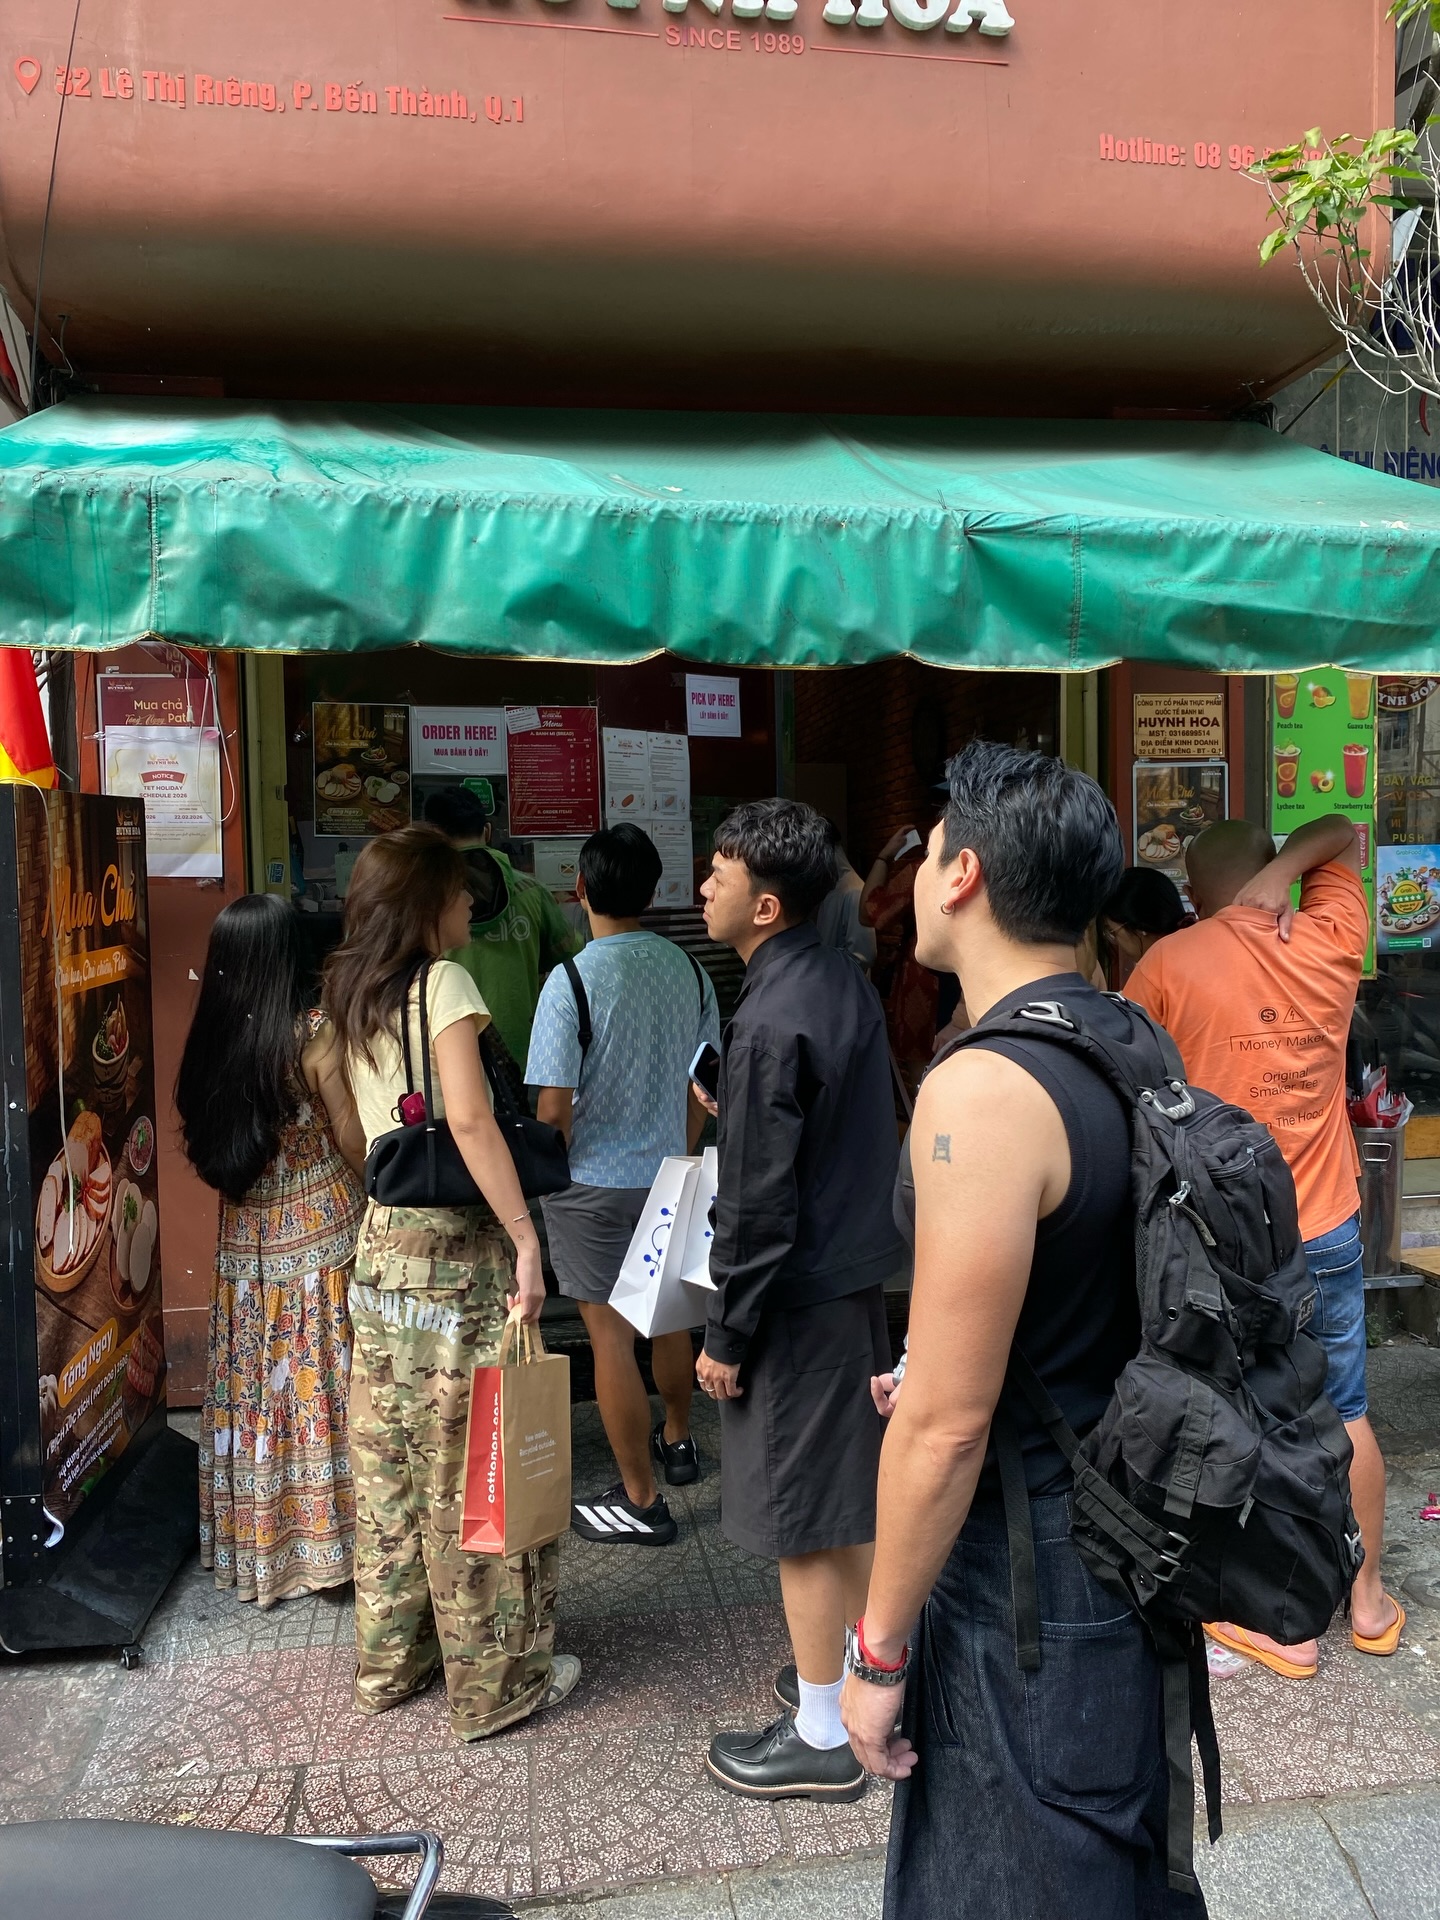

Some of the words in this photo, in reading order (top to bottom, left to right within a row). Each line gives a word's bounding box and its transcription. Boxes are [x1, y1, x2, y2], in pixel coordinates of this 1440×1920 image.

[665, 25, 742, 51] SINCE
[750, 32, 806, 55] 1989
[55, 65, 92, 97] 32
[100, 67, 134, 99] Lê
[142, 71, 186, 109] Thị
[194, 74, 286, 113] Riêng,
[293, 80, 319, 110] P.
[324, 80, 378, 113] Bến
[384, 84, 477, 123] Thành,
[485, 95, 524, 124] Q.1
[1100, 132, 1186, 167] Hotline:
[1194, 141, 1221, 169] 08
[1229, 144, 1255, 171] 96
[1383, 445, 1440, 479] RIÊN
[691, 692, 707, 706] PICK
[707, 693, 717, 706] UP
[717, 693, 736, 707] HERE!
[1409, 679, 1438, 703] HOA
[134, 700, 159, 710] Mua
[161, 698, 183, 710] chả
[1137, 698, 1154, 706] CÔNG
[542, 720, 563, 728] Menu
[1138, 717, 1185, 728] HUYNH
[1190, 716, 1220, 728] HOA
[1347, 722, 1364, 730] Guava
[422, 724, 460, 740] ORDER
[464, 725, 497, 741] HERE!
[433, 748, 449, 756] MUA
[152, 772, 174, 780] NOTICE
[1276, 803, 1295, 811] Lychee
[1334, 803, 1364, 811] Strawberry
[1392, 833, 1425, 843] PUSH
[42, 865, 97, 938] Mua
[100, 863, 138, 927] Chả
[112, 950, 127, 973] Pate
[1239, 1038, 1282, 1051] Money
[1286, 1034, 1327, 1047] Maker
[1262, 1067, 1310, 1084] Original
[1249, 1083, 1297, 1099] Smaker
[1300, 1079, 1319, 1090] Tee
[1275, 1116, 1296, 1129] The
[1297, 1106, 1325, 1123] Hood
[63, 1354, 88, 1395] Tặng
[88, 1327, 114, 1366] Ngay
[93, 1379, 104, 1400] HOT
[103, 1368, 114, 1388] DOG
[487, 1391, 500, 1504] cottonon.com
[66, 1447, 80, 1468] dụng
[62, 1473, 73, 1492] chả
